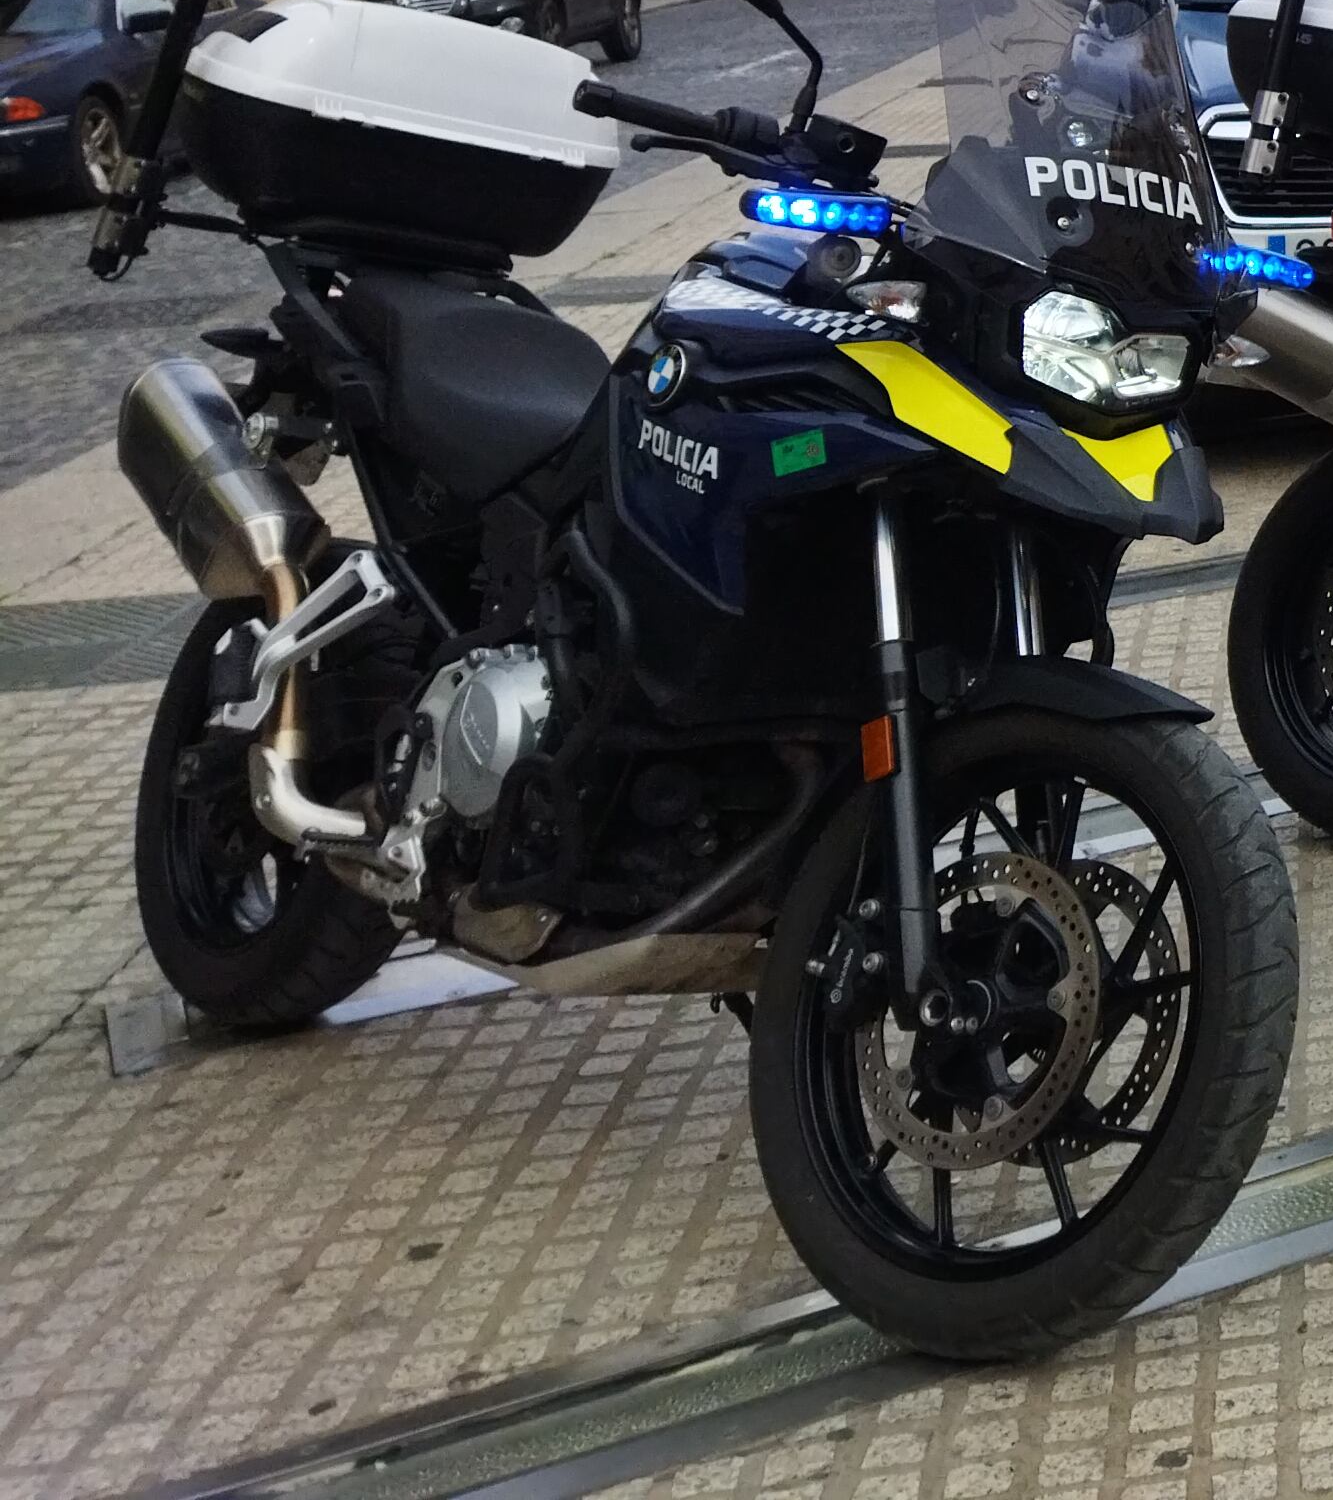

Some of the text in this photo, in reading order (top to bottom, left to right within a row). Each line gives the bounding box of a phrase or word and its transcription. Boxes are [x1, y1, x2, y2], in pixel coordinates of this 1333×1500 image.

[1024, 156, 1204, 226] POLICIA
[637, 419, 720, 480] POLICIA
[676, 469, 706, 495] LOCAL
